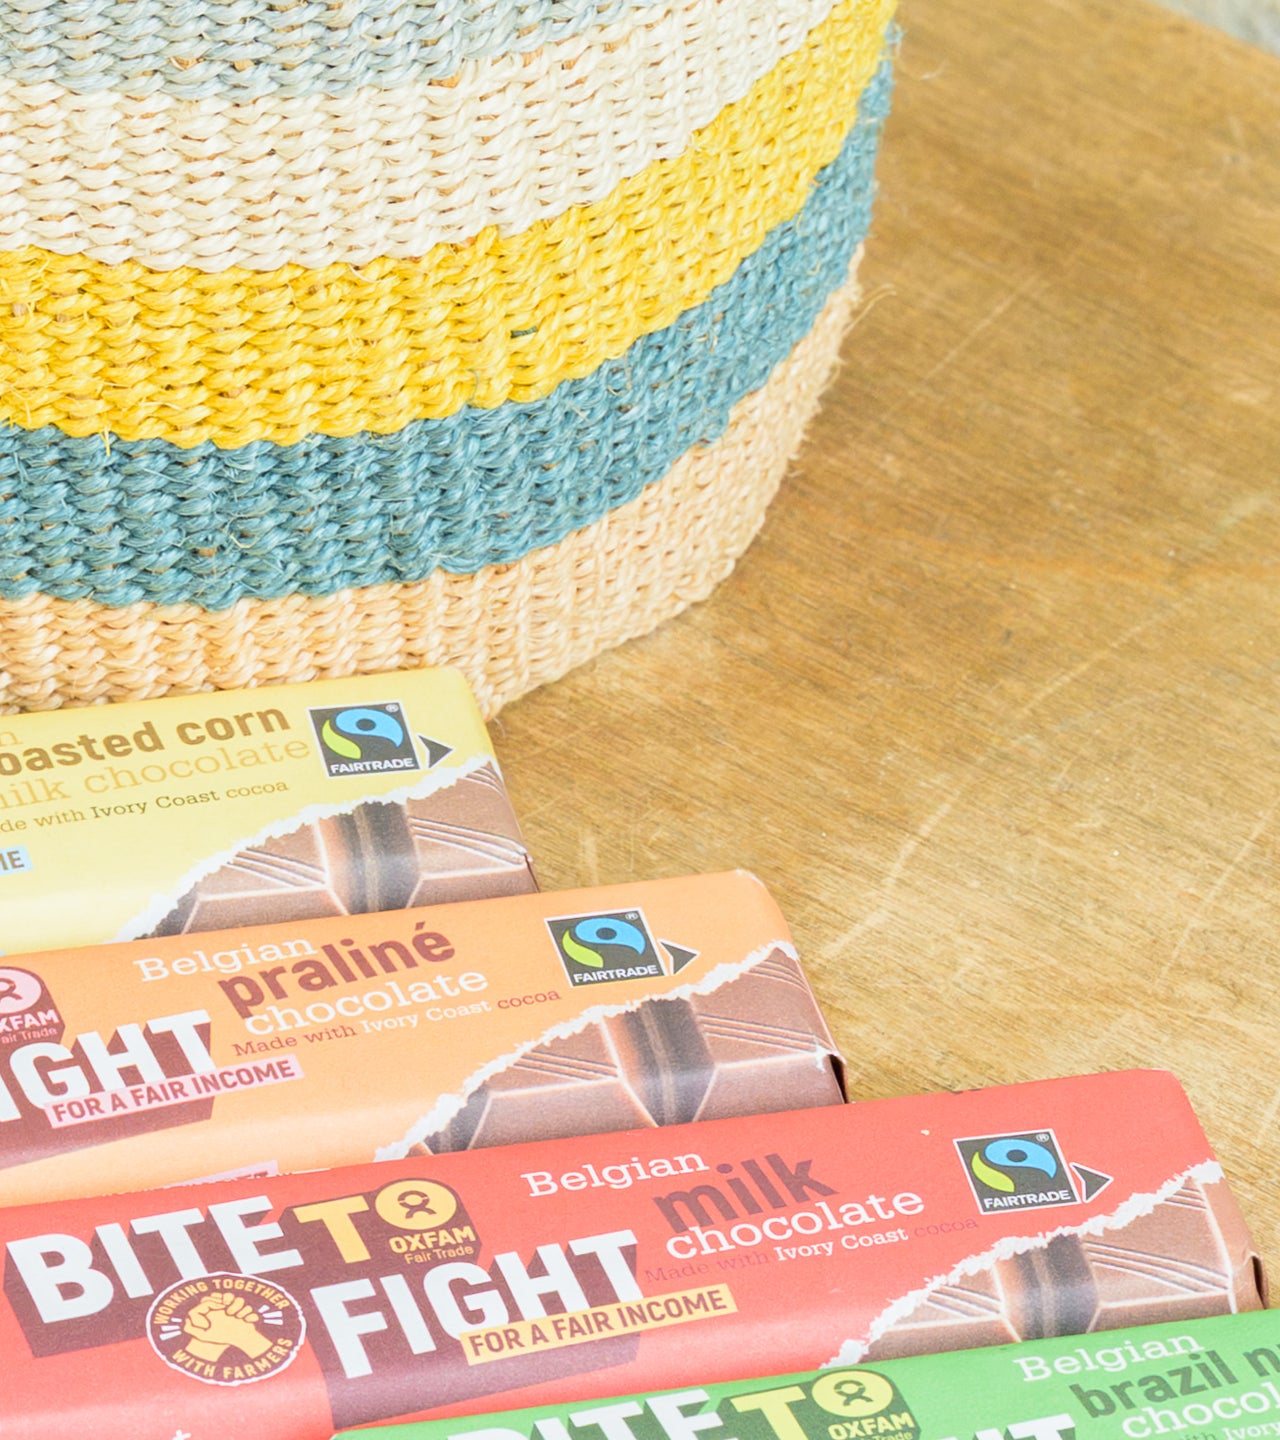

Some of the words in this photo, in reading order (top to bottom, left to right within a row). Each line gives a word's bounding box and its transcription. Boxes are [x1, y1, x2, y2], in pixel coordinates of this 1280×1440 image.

[175, 707, 289, 747] corn
[83, 734, 311, 791] chocolate
[330, 755, 414, 774] FAIRTRADE
[33, 809, 87, 829] with
[91, 799, 147, 822] Ivory
[155, 788, 220, 810] Coast
[226, 778, 288, 799] cocoa
[134, 938, 318, 983] Belgian
[218, 922, 456, 1019] praliné
[573, 963, 659, 983] FAIRTRADE
[245, 967, 489, 1038] chocolate
[52, 1099, 106, 1120] FOR
[109, 1092, 128, 1111] A
[132, 1083, 190, 1107] FAIR
[194, 1060, 296, 1096] INCOME
[520, 1151, 710, 1198] Belgian
[653, 1153, 839, 1233] milk
[983, 1190, 1071, 1209] FAIRTRADE
[389, 1225, 475, 1254] OXFAM
[666, 1188, 925, 1260] chocolate
[6, 1195, 303, 1324] BITE
[153, 1281, 209, 1326] WORKING
[212, 1278, 290, 1310] TOGETHER
[311, 1230, 644, 1379] FIGHT
[471, 1330, 522, 1356] FOR
[528, 1324, 548, 1345] A
[554, 1313, 610, 1342] FAIR
[616, 1289, 728, 1329] INCOME
[172, 1349, 217, 1380] WITH
[222, 1337, 293, 1380] FARMERS
[1013, 1332, 1205, 1384] Belgian
[1069, 1351, 1238, 1419] brazil
[827, 1411, 915, 1440] OXFAM
